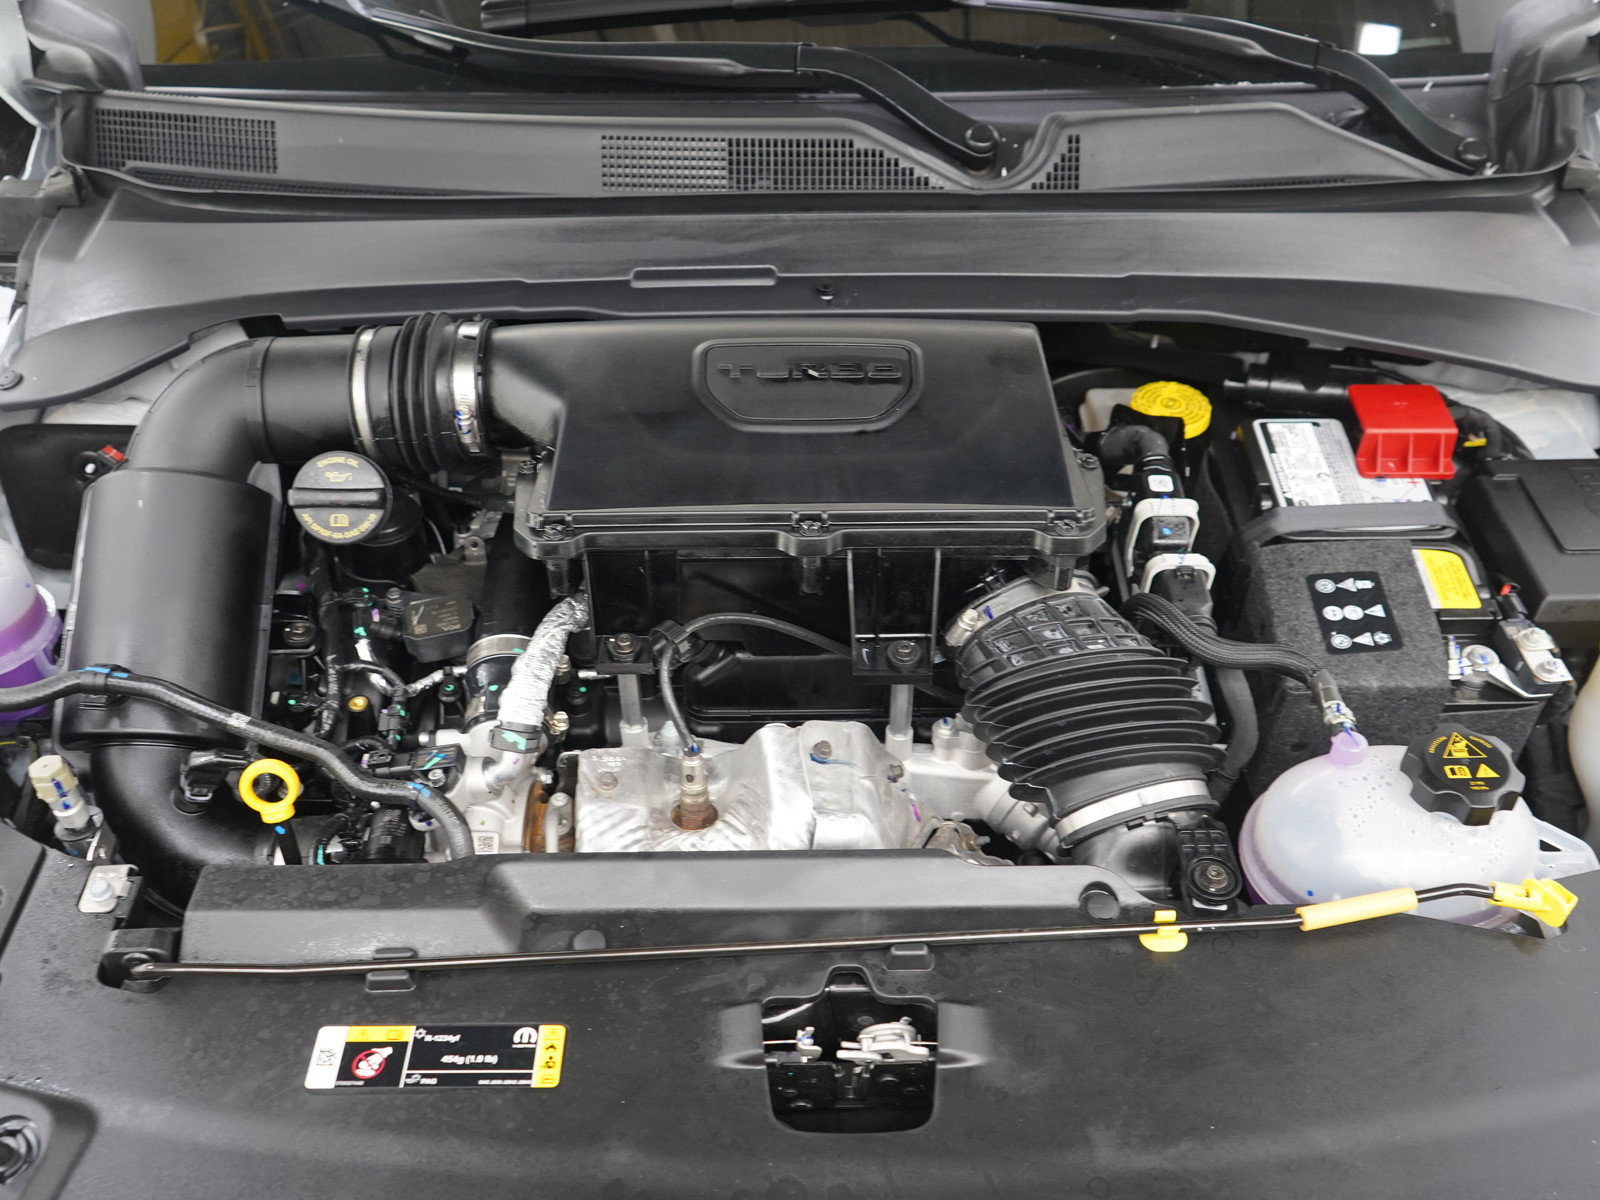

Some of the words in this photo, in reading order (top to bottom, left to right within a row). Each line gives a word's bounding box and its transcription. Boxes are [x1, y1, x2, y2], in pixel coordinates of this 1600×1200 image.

[717, 362, 903, 380] TURBO
[315, 456, 346, 468] ENGINE
[346, 458, 360, 468] OIL
